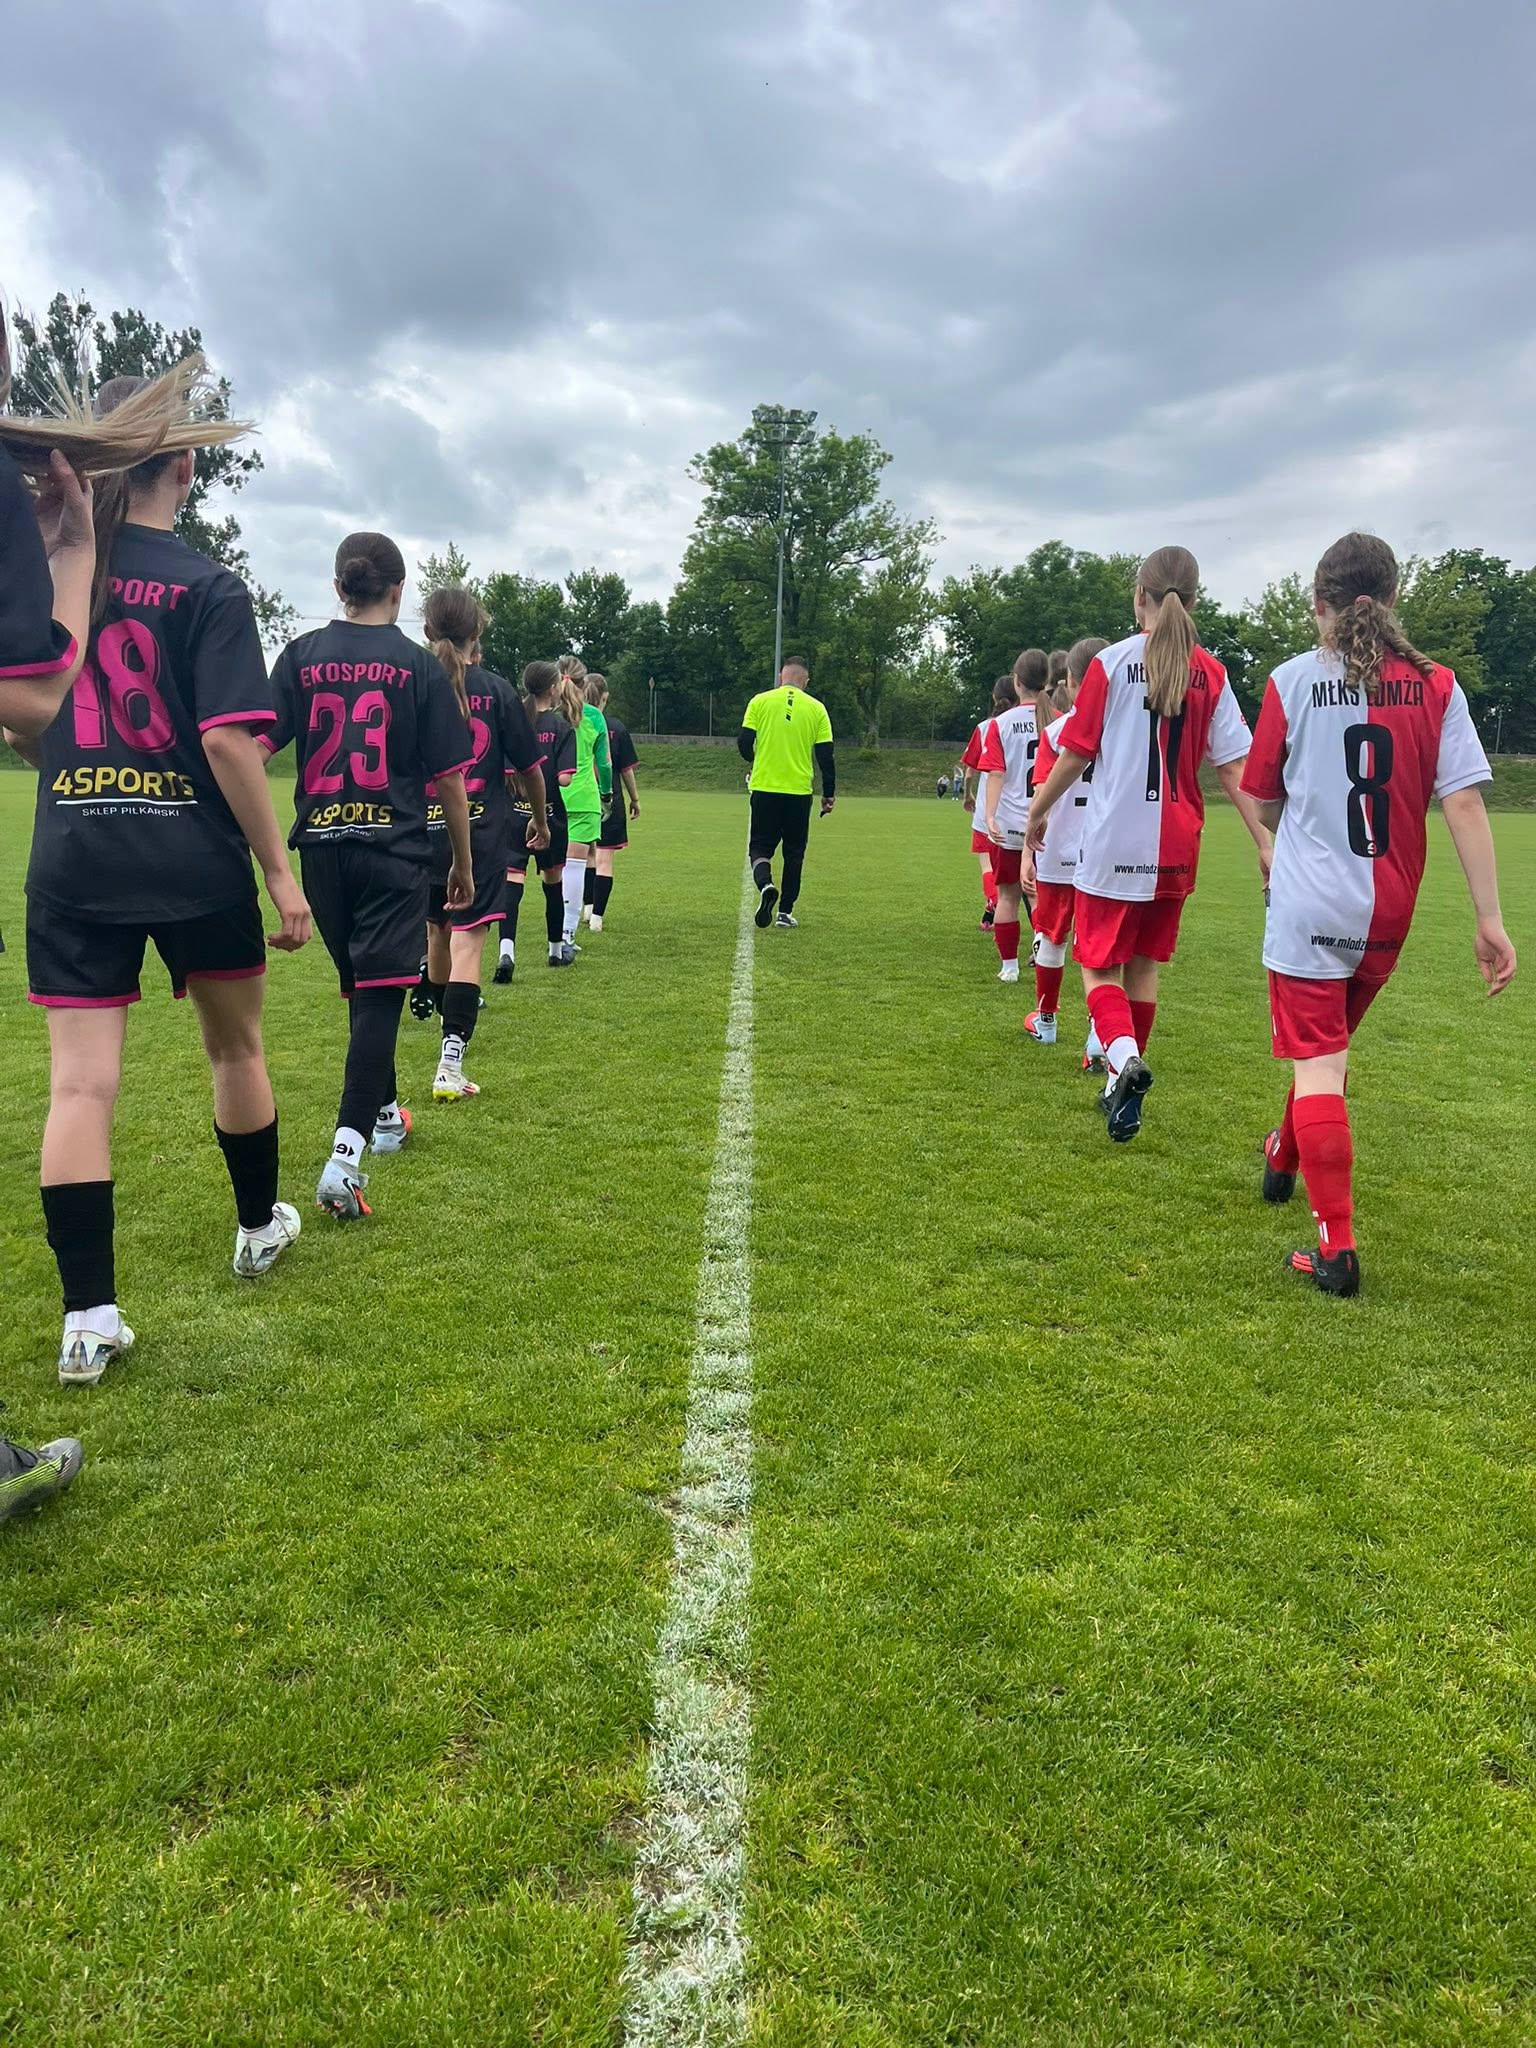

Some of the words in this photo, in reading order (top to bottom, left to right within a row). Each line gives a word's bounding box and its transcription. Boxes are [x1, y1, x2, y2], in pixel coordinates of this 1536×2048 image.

[73, 618, 177, 753] 18
[301, 662, 412, 689] EKOSPORT
[1312, 679, 1360, 708] MŁKS
[304, 690, 392, 796] 23
[1143, 695, 1187, 802] 17
[52, 766, 194, 796] 4SPORTS
[1343, 723, 1393, 858] 8
[82, 806, 117, 817] SKLEP
[121, 807, 180, 817] PIŁKARSKI
[307, 802, 393, 826] 4SPORTS
